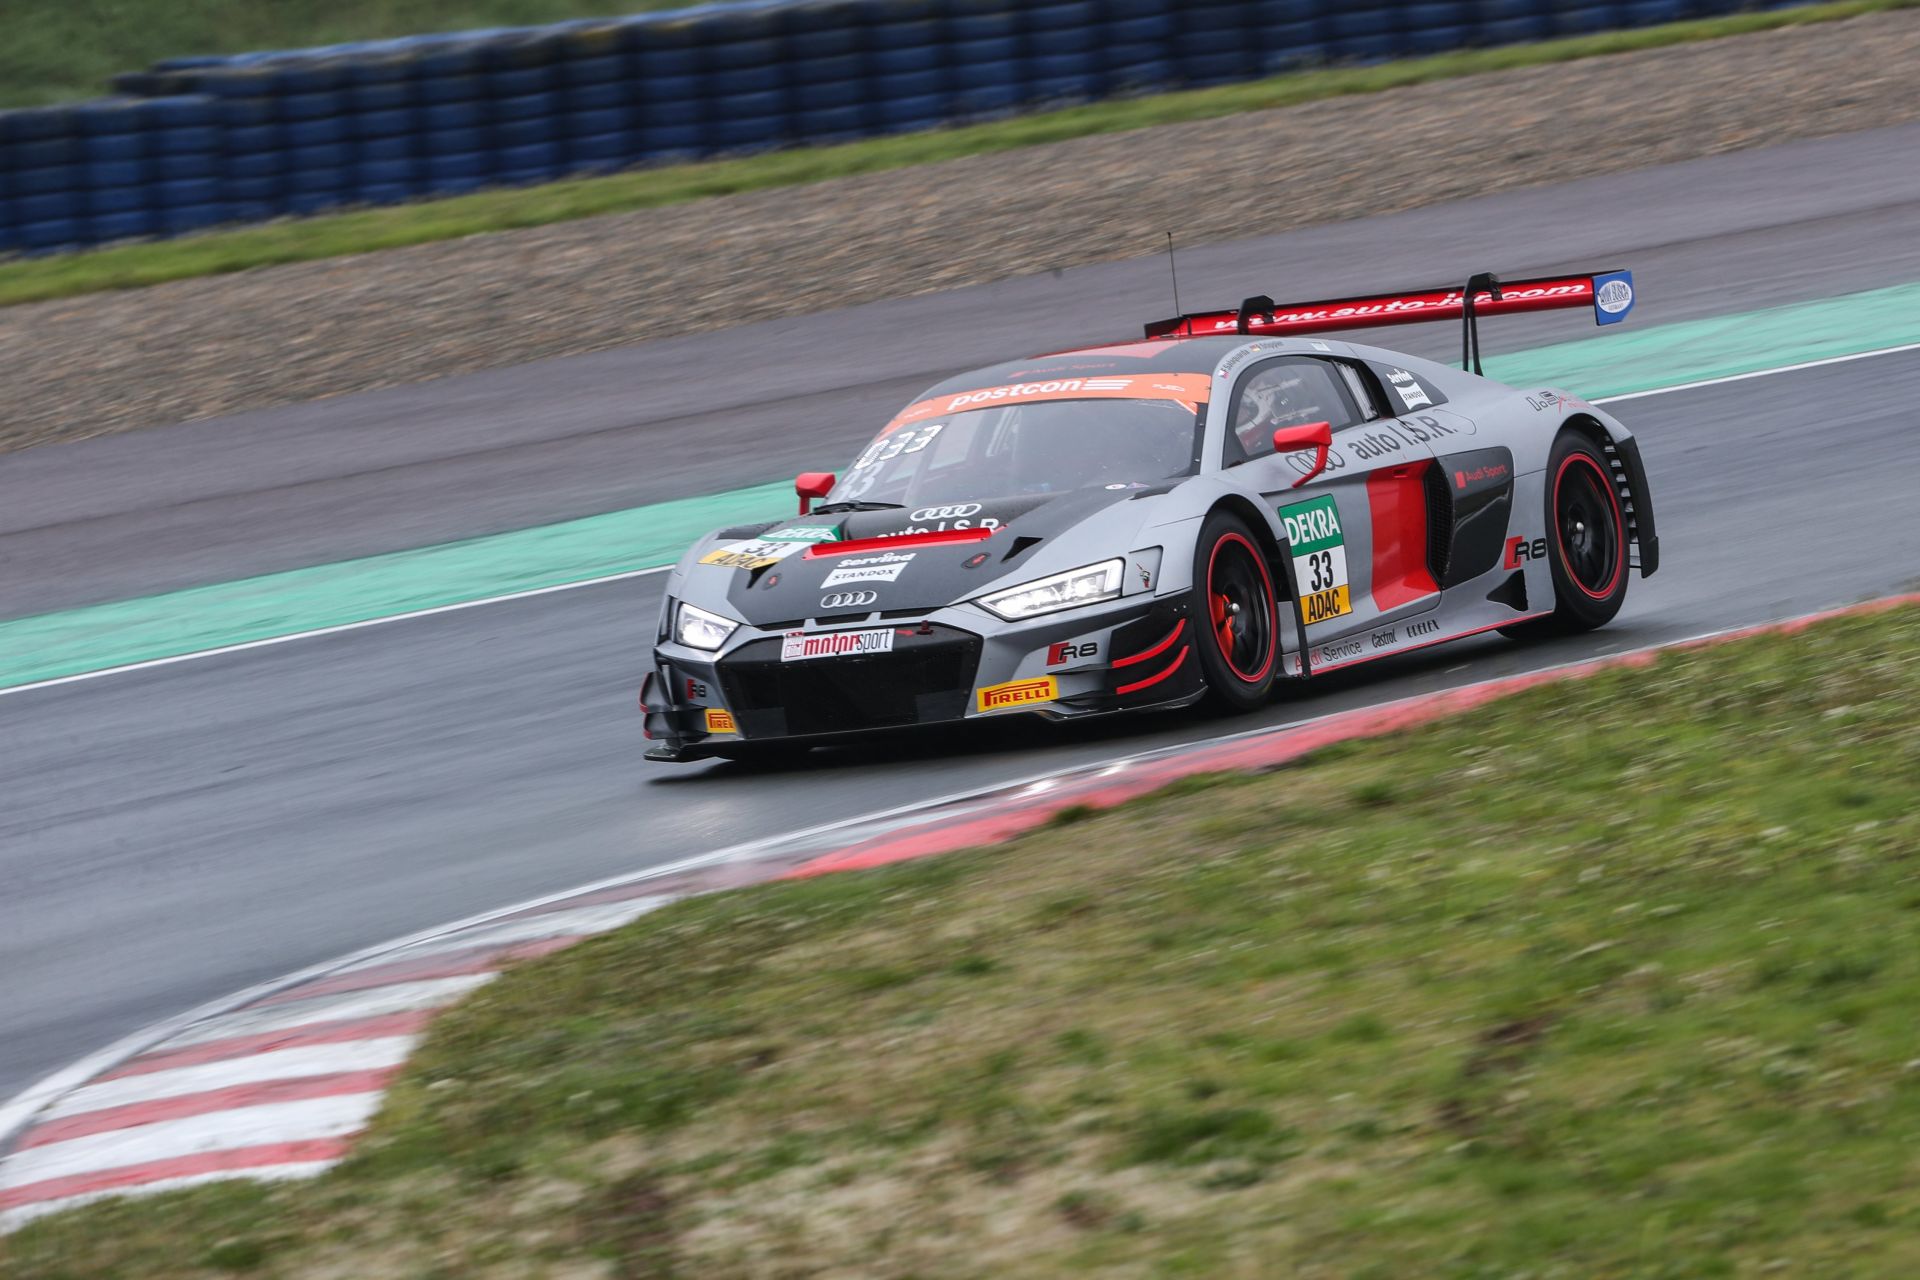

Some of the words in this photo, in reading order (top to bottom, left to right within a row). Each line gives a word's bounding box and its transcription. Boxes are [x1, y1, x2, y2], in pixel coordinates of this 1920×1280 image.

[947, 380, 1083, 411] postcon
[1347, 432, 1401, 460] auto
[1465, 469, 1484, 481] Audi
[1483, 464, 1508, 478] Sport
[1284, 506, 1341, 546] DEKRA
[709, 552, 768, 569] ADAC
[744, 542, 791, 557] 33
[1512, 537, 1546, 564] R8
[832, 568, 896, 581] STANDOX
[1309, 551, 1334, 592] 33
[1308, 589, 1340, 622] ADAC
[803, 628, 890, 656] motorsport
[1058, 642, 1098, 661] R8
[1371, 628, 1398, 648] Castrol
[1295, 648, 1323, 671] Adi
[1324, 640, 1363, 663] Service
[984, 681, 1050, 707] PIRELLI
